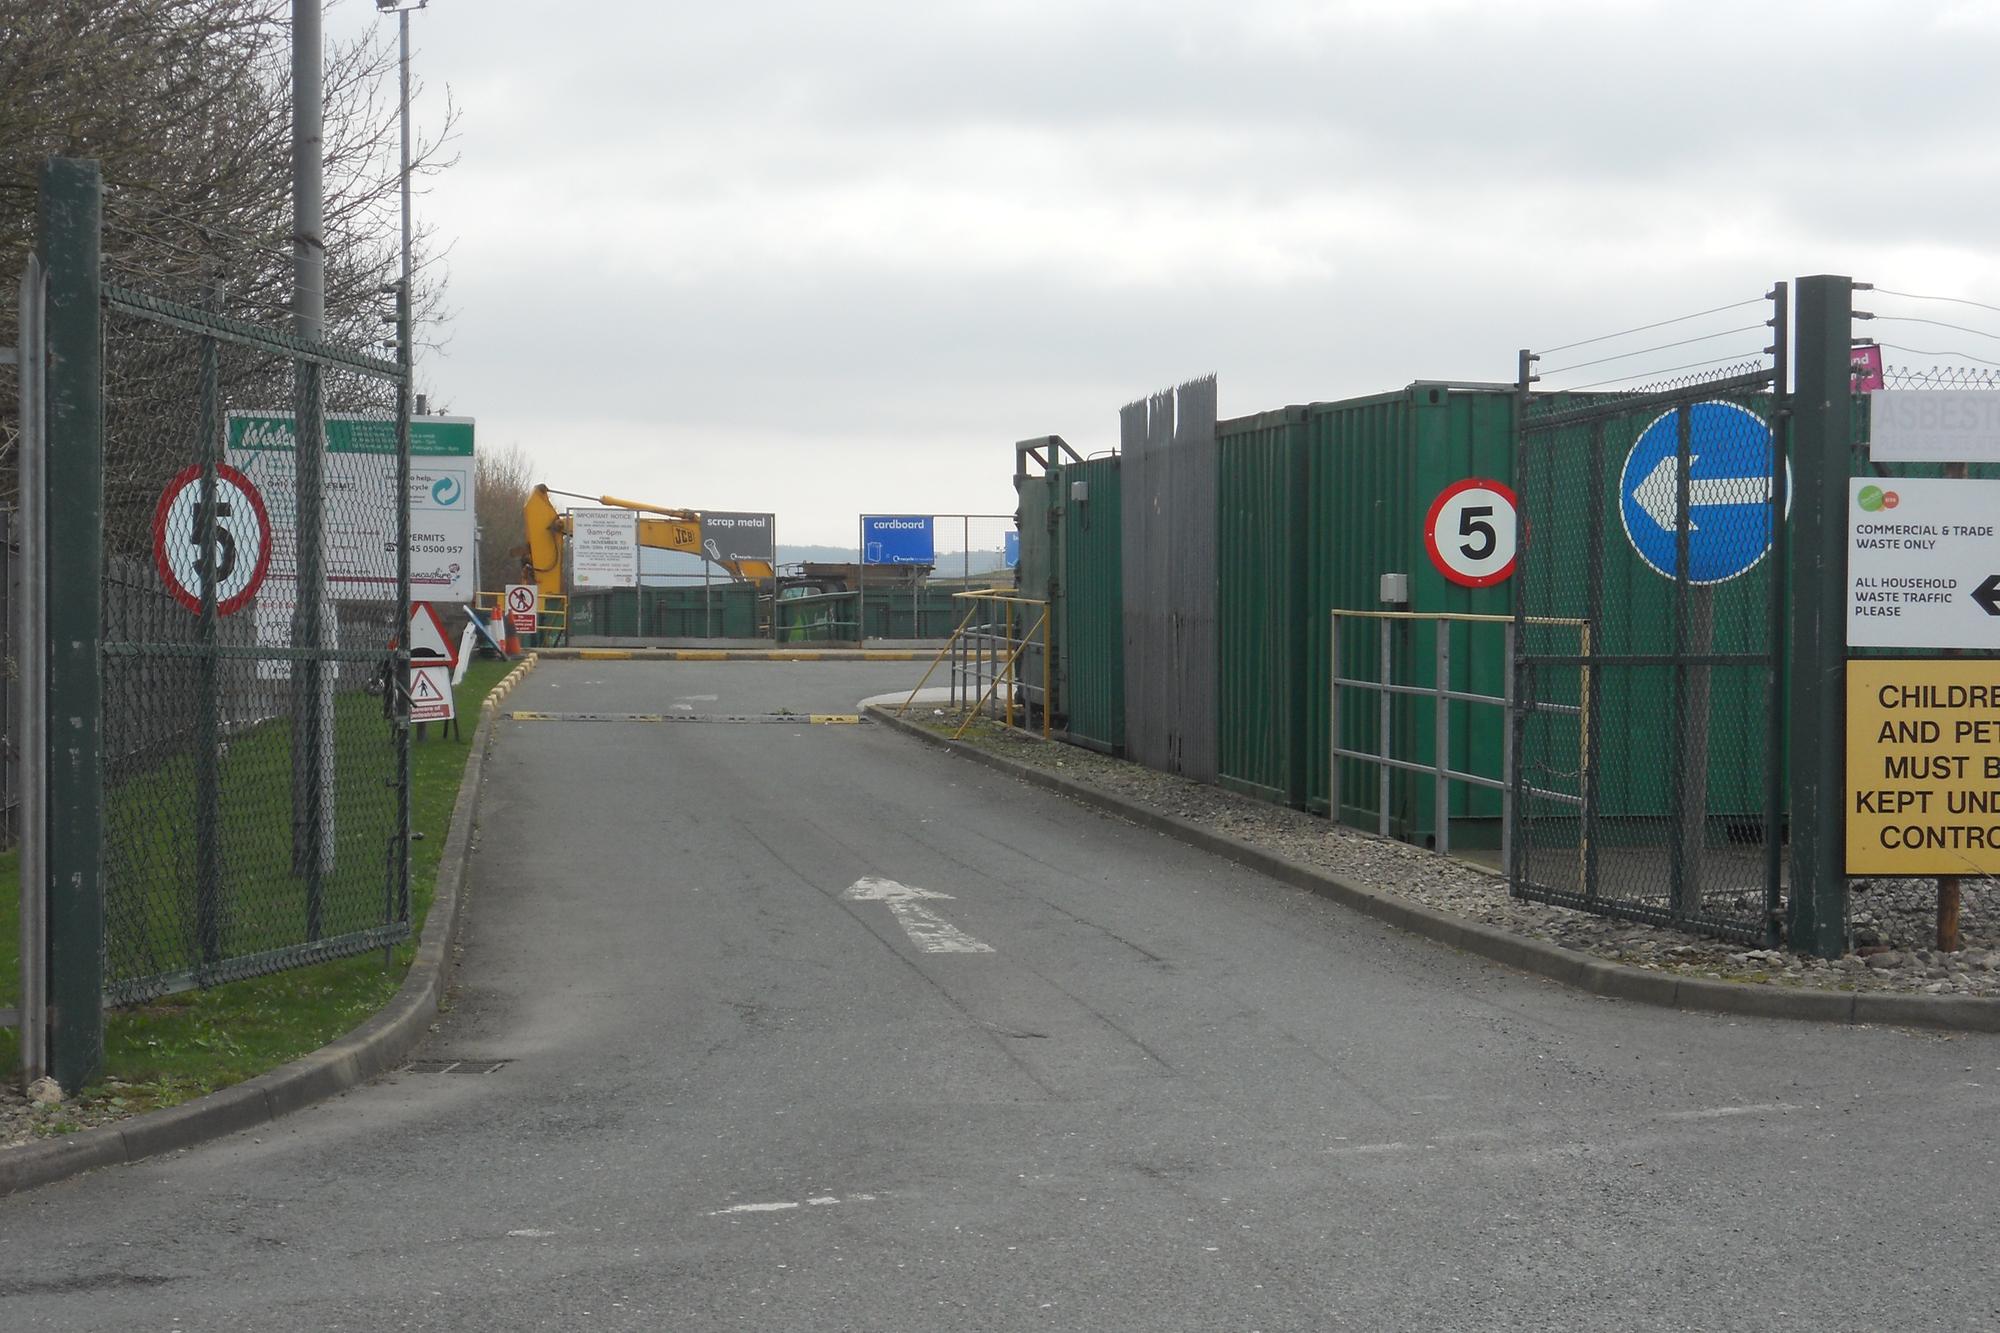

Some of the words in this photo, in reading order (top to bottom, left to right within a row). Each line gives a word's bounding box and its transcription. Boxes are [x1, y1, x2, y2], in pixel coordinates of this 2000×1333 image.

[1879, 395, 2000, 430] ASBEST
[707, 518, 735, 528] scrap
[737, 518, 766, 528] metal
[873, 520, 925, 530] cardboard
[675, 528, 694, 544] JCB
[1458, 505, 1496, 560] 5
[1856, 524, 1938, 536] COMMERCIAL
[1942, 525, 1950, 536] &
[1953, 526, 1994, 536] TRADE
[191, 502, 236, 585] 5
[410, 533, 446, 542] ERMITS
[422, 545, 445, 553] 0500
[446, 546, 463, 554] 957
[1856, 538, 1900, 550] WASTE
[1903, 540, 1936, 550] ONLY
[410, 567, 452, 579] ancashire
[1856, 577, 1878, 588] ALL
[1881, 578, 1958, 589] HOUSEHOLD
[1856, 592, 1900, 602] WASTE
[1902, 592, 1952, 604] TRAFFIC
[1855, 606, 1902, 616] PLEASE
[1877, 720, 1941, 744] AND
[1885, 756, 1970, 780] MUST
[1856, 790, 1934, 814] KEPT
[1880, 825, 2000, 849] CONTRO
